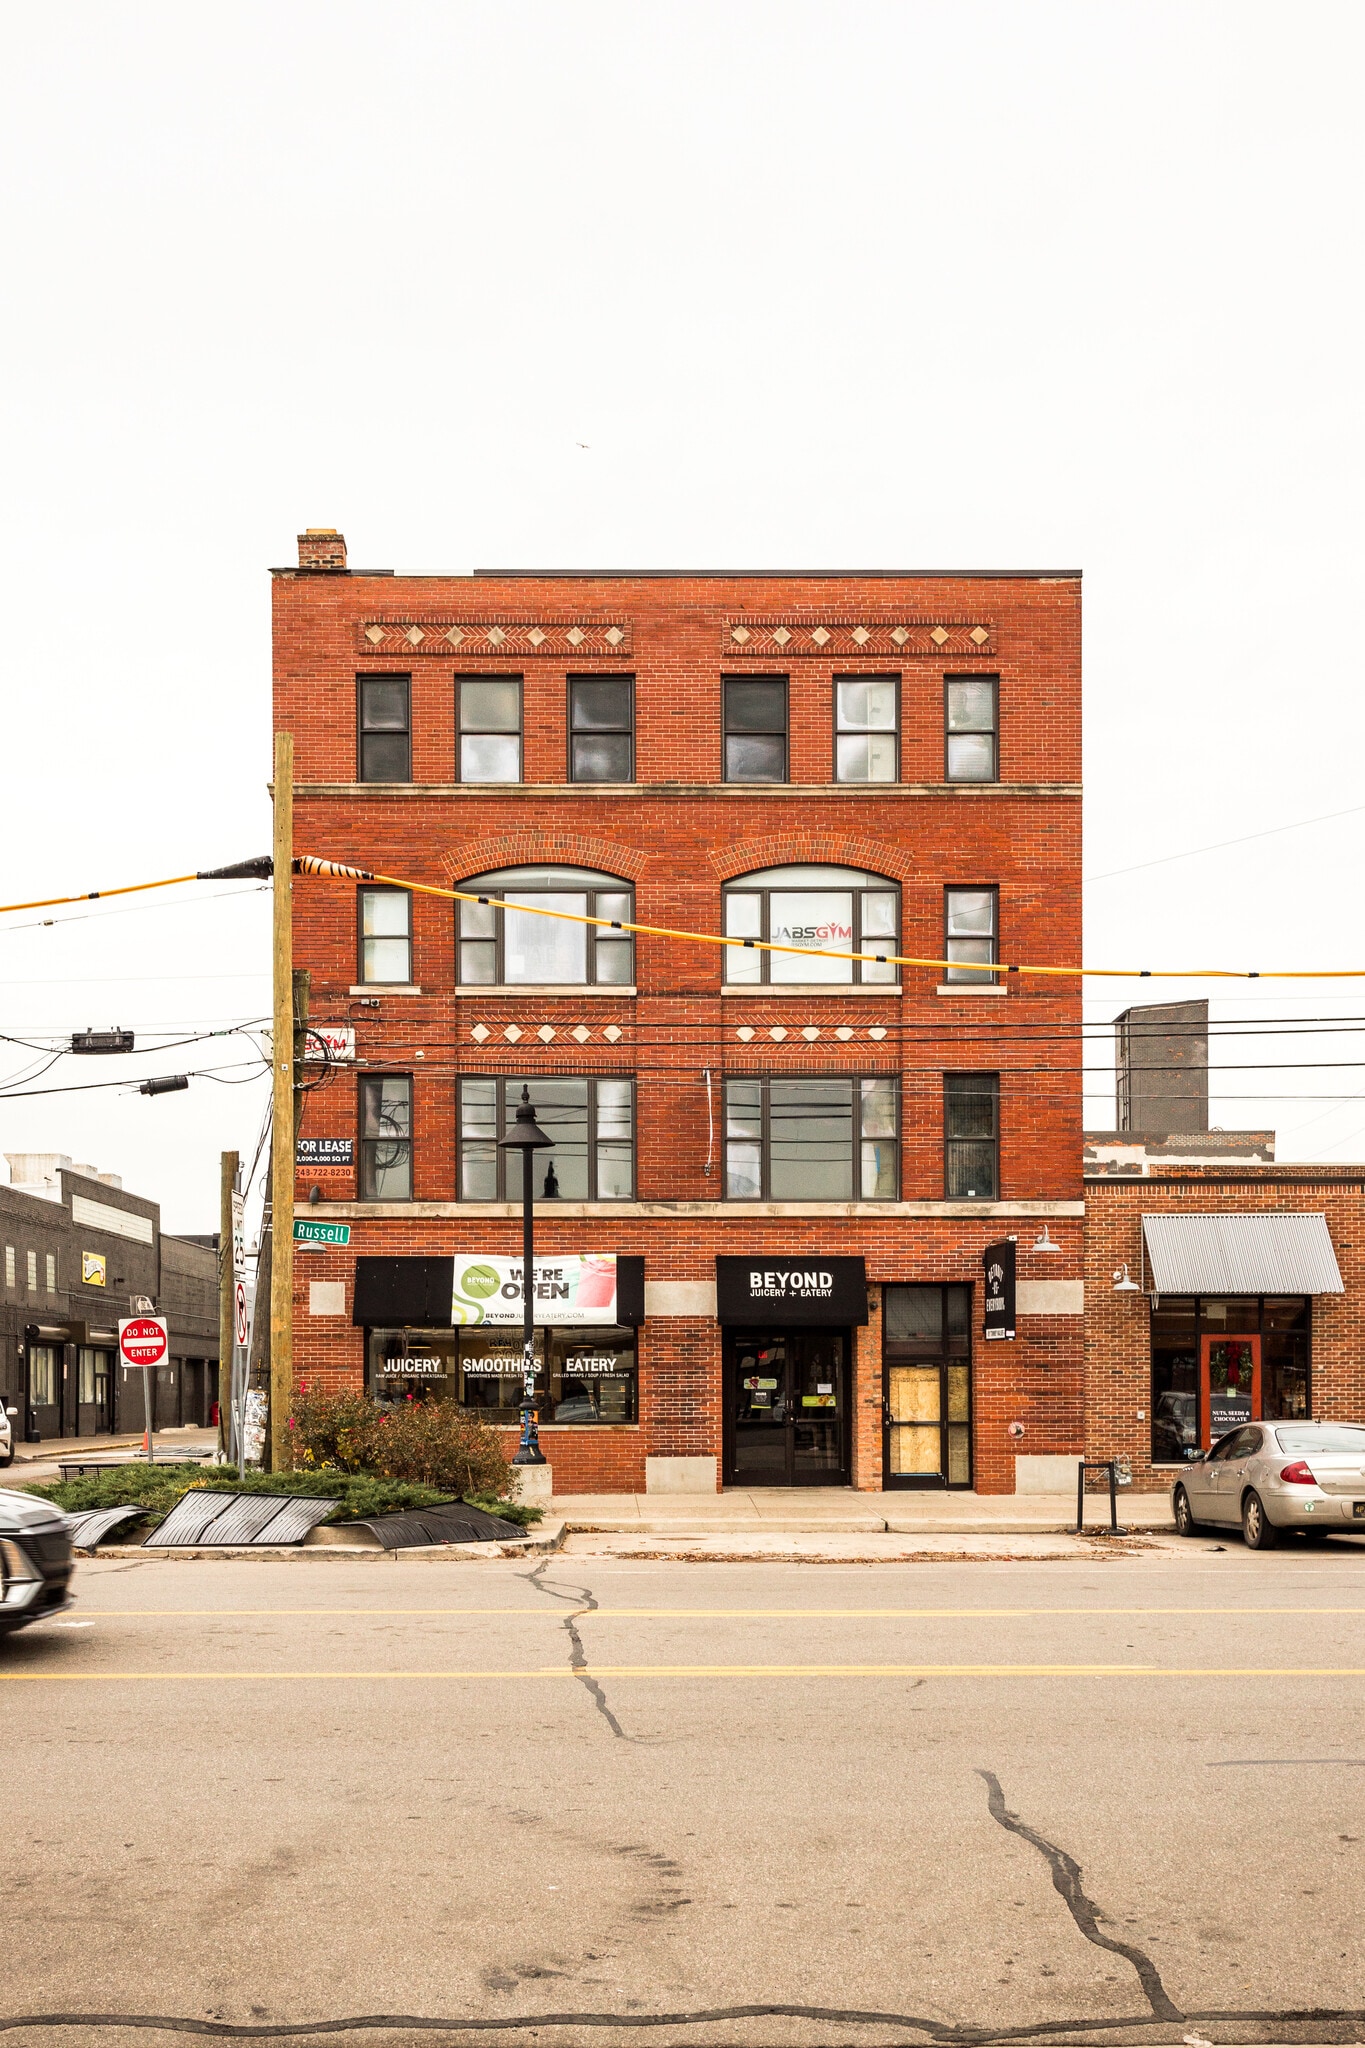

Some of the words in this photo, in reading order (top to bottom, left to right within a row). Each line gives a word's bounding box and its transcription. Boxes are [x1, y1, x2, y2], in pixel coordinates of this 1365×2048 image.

[319, 1140, 352, 1153] LEASE
[298, 1224, 344, 1241] Russell
[234, 1235, 245, 1266] 25
[749, 1272, 833, 1288] BEYOND
[750, 1289, 786, 1297] JUICERY
[800, 1289, 833, 1297] EATERY
[126, 1328, 138, 1337] DO
[142, 1327, 159, 1336] NOT
[131, 1348, 158, 1357] ENTER
[383, 1358, 441, 1373] JUICERY
[462, 1358, 542, 1372] SMOOTHIS
[566, 1358, 617, 1372] EATERY
